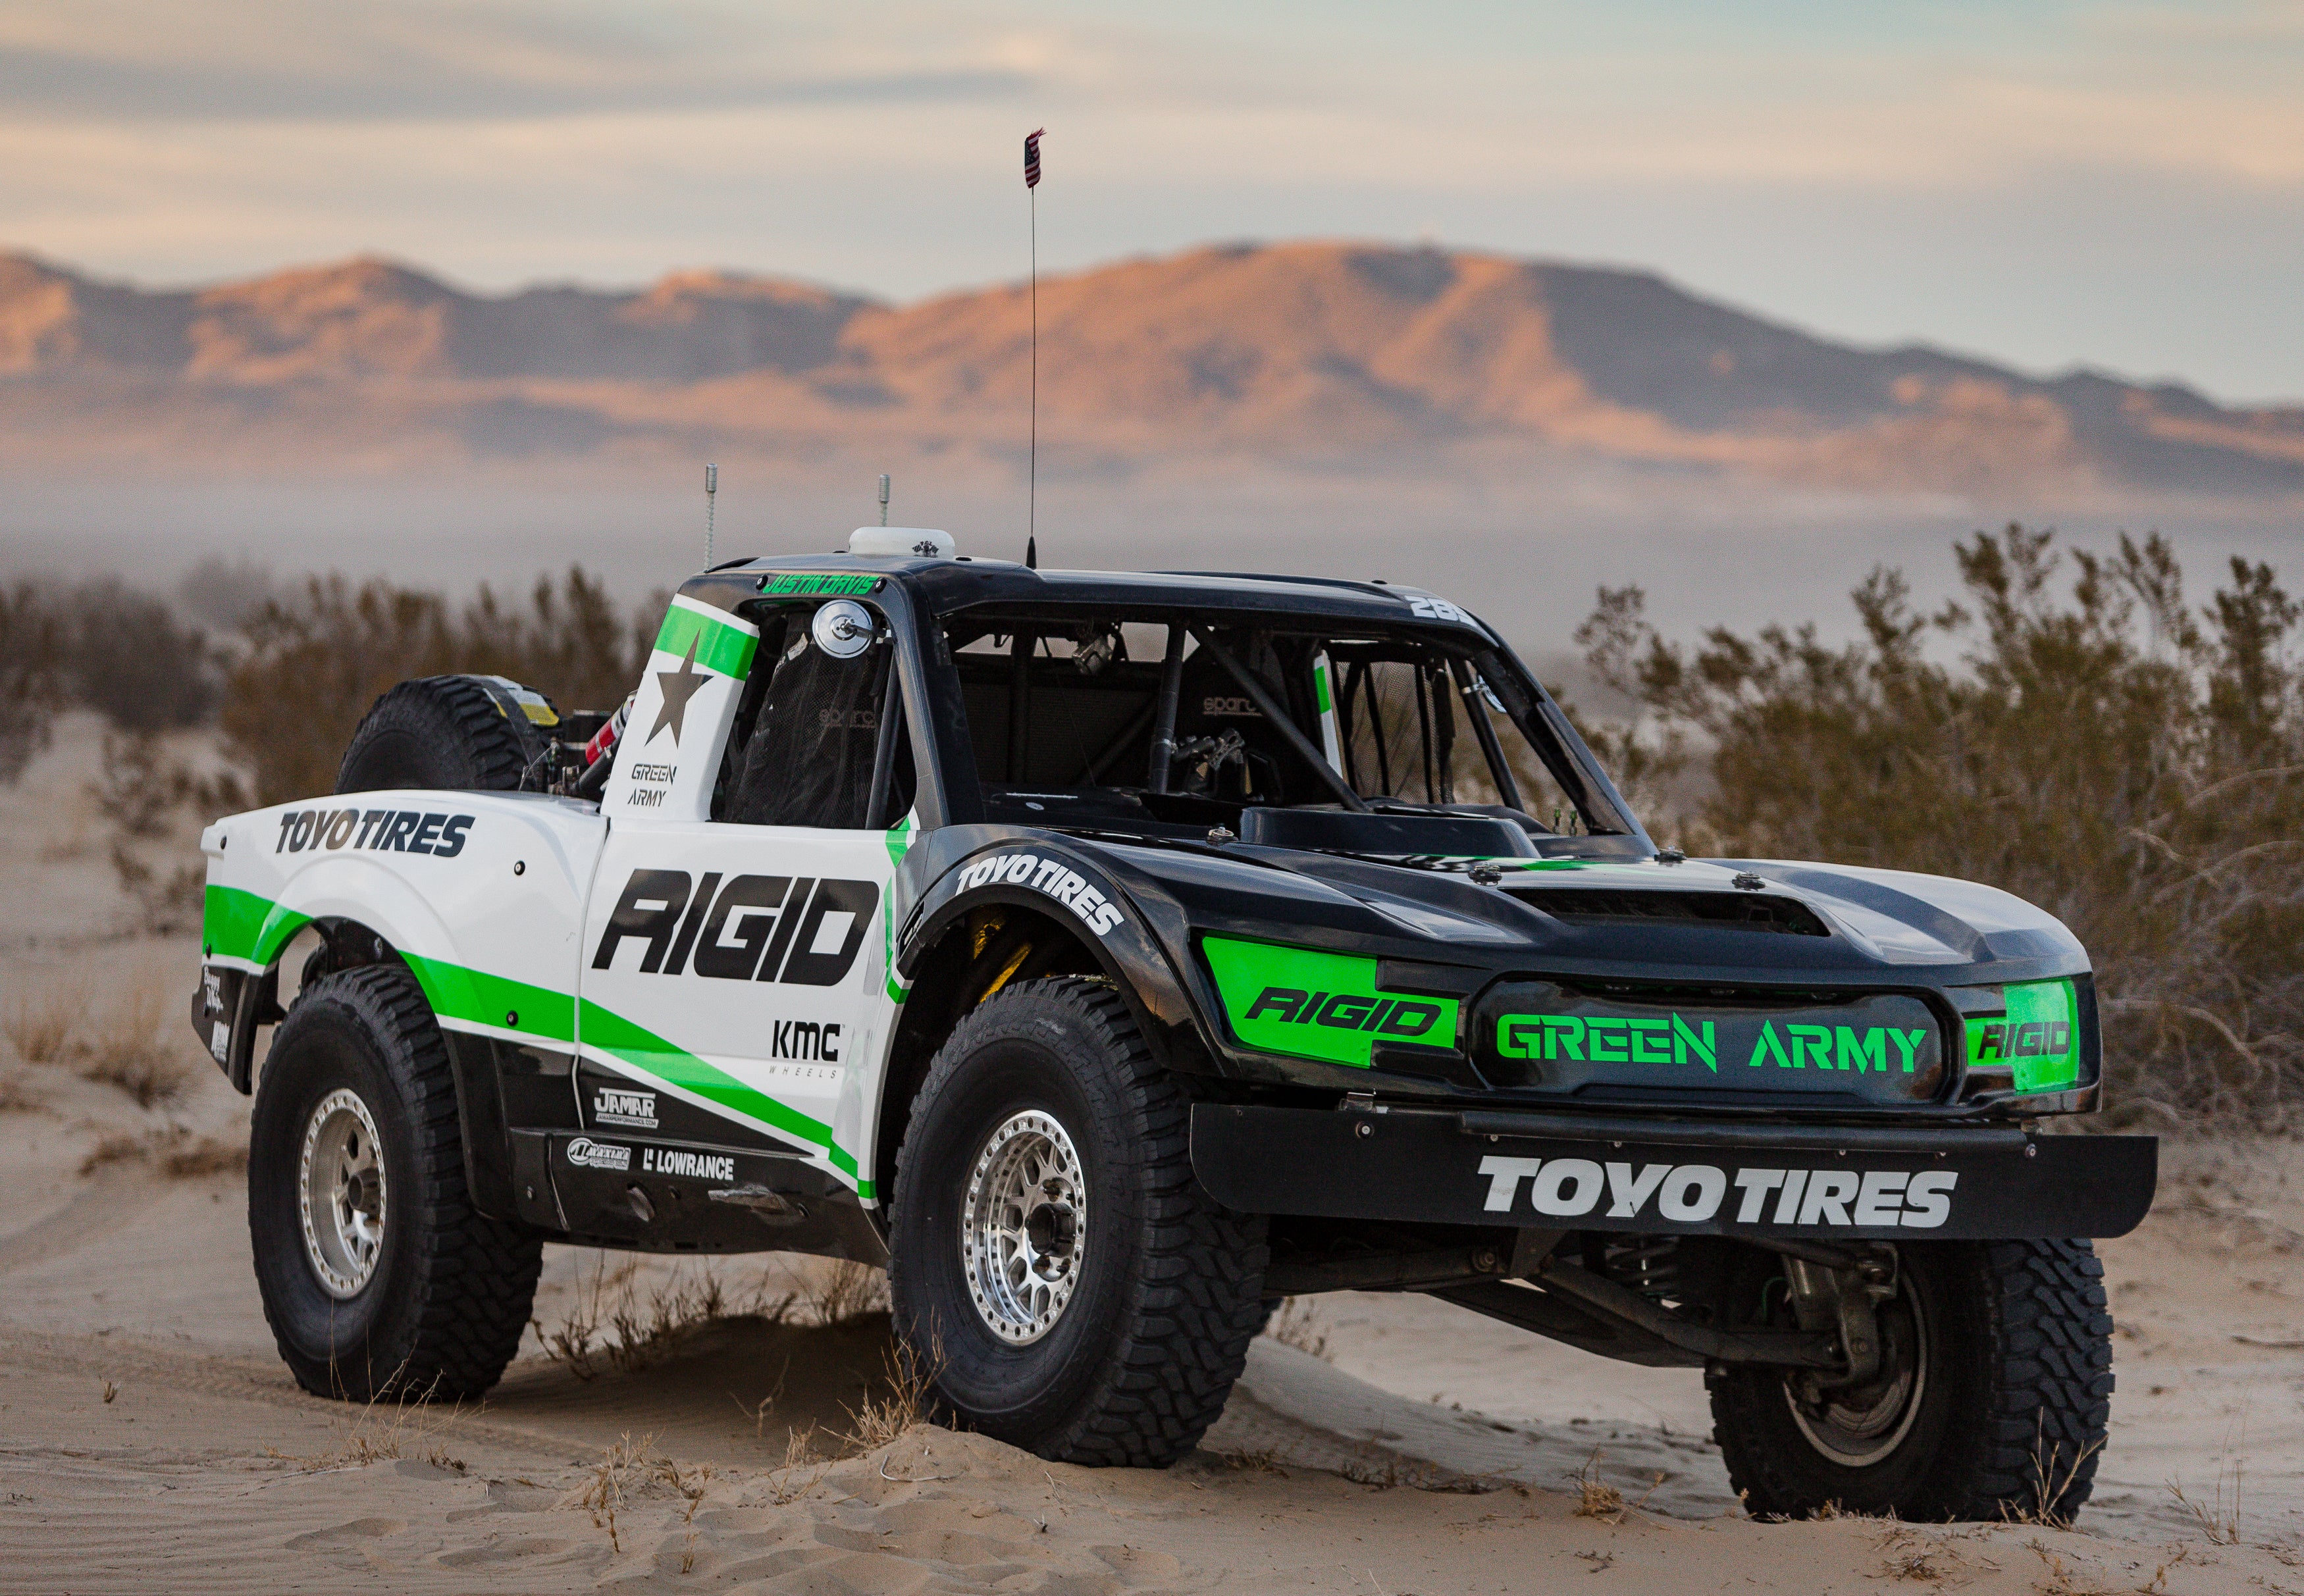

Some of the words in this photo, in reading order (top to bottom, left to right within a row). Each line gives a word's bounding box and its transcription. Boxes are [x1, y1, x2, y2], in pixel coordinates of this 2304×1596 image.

[762, 574, 826, 594] JUSTIN
[819, 575, 879, 595] DAVIS
[1203, 697, 1260, 716] sparc
[631, 763, 677, 785] GREEN
[627, 787, 667, 807] ARMY
[276, 808, 359, 853] TOYO
[353, 809, 476, 858] TIRES
[955, 854, 1038, 896] TOYO
[1030, 858, 1125, 936] TIRES
[591, 868, 879, 987] RIGID
[1244, 986, 1442, 1037] RIGID
[1497, 1012, 1717, 1073] GREEN
[1748, 1019, 1927, 1075] ARMY
[1977, 1021, 2071, 1060] RIGID
[769, 1066, 837, 1079] WHEELS
[594, 1087, 656, 1118] JAMAR
[657, 1150, 734, 1181] LOWRANCE
[1477, 1156, 1727, 1222] TOYO
[1734, 1168, 1958, 1228] TIRES
